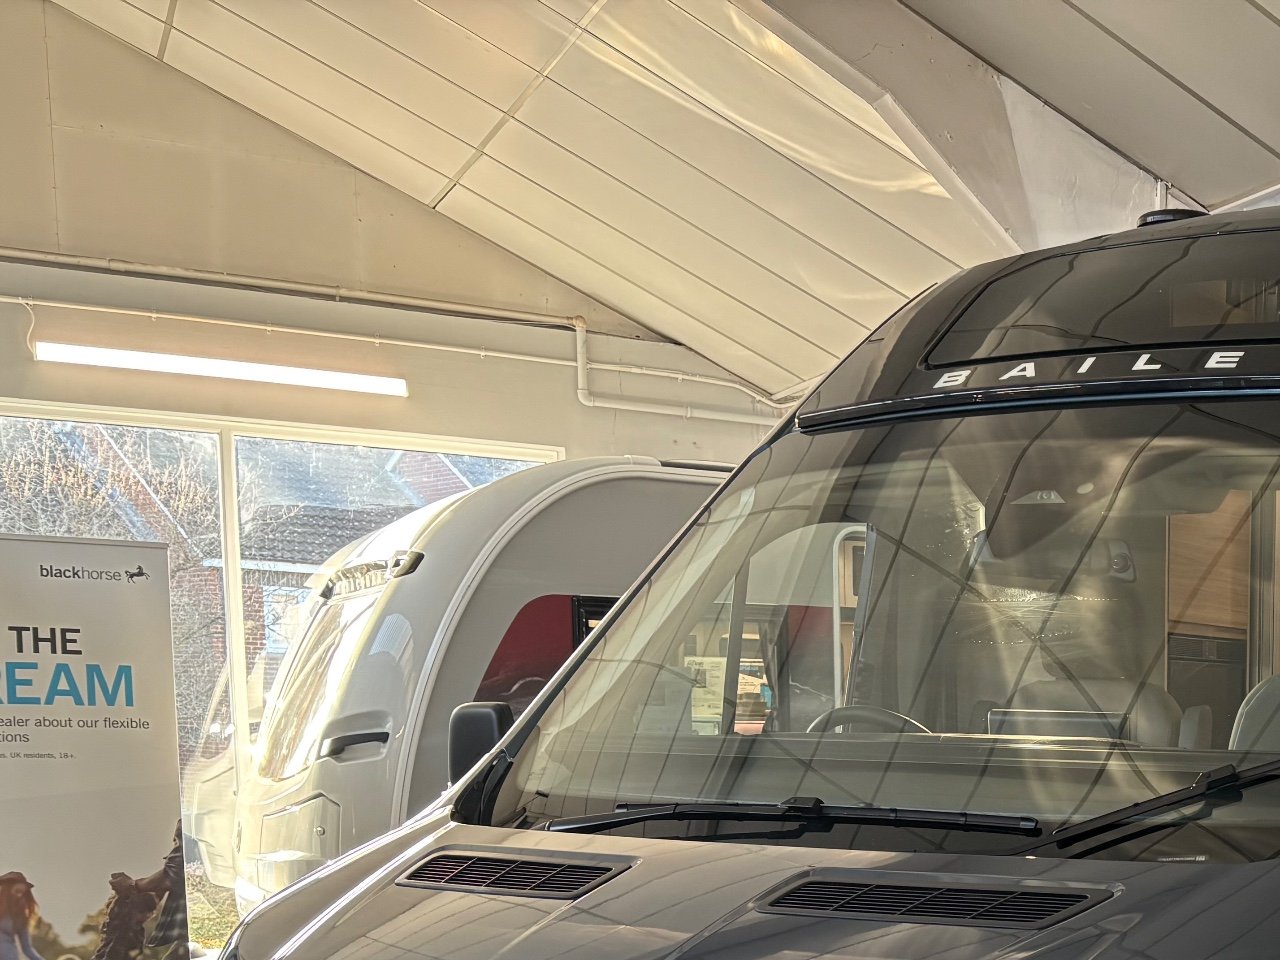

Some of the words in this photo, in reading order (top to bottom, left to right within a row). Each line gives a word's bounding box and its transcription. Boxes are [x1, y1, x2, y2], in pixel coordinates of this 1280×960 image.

[39, 565, 122, 582] blackhorse
[8, 626, 82, 655] THE
[0, 661, 134, 707] EAM
[34, 716, 73, 728] about
[77, 718, 100, 729] our
[103, 716, 150, 729] flexible
[10, 751, 22, 759] UK
[23, 752, 57, 760] residents,
